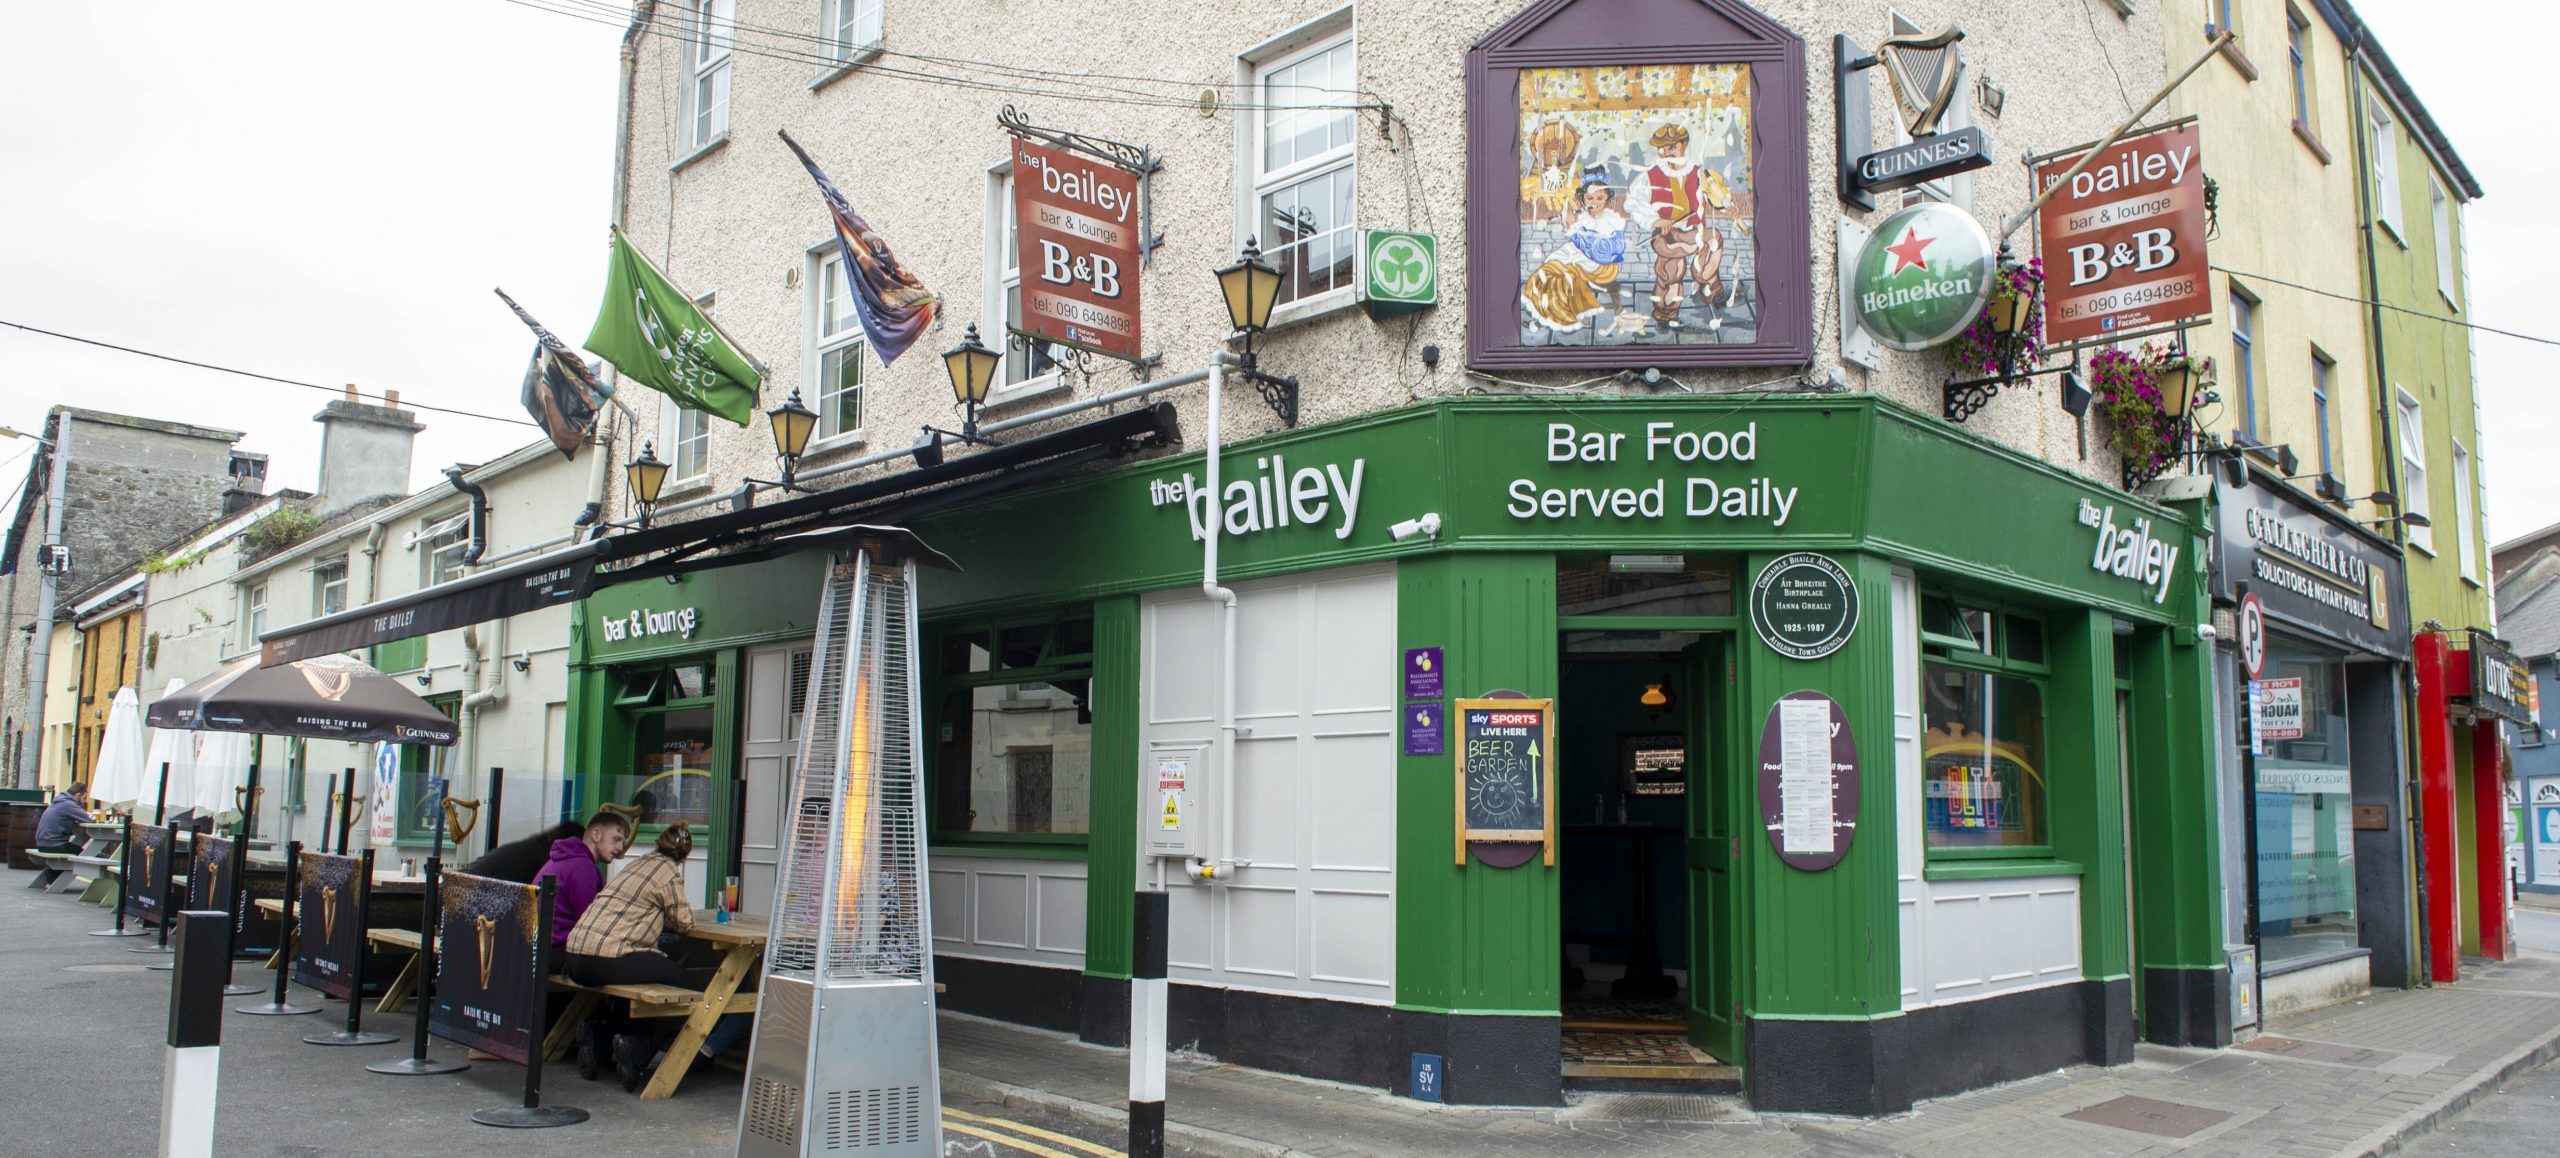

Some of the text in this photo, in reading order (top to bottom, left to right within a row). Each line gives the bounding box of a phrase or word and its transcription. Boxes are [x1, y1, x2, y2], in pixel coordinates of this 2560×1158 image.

[1862, 135, 1970, 179] GUINNESS
[1019, 150, 1132, 223] the bailey
[1040, 207, 1118, 244] bar & lounge
[2069, 197, 2171, 231] bar & lounge
[1039, 238, 1121, 299] B&B
[2067, 227, 2176, 288] B&B
[1862, 276, 1974, 315] Heineken
[2061, 280, 2194, 319] tel: 090 6494898
[1034, 296, 1131, 333] tel: 090 6494898
[2117, 314, 2151, 328] Facebook
[1547, 421, 1756, 461] Bar Food
[1150, 454, 1366, 541] the bailey
[1507, 477, 1798, 527] Served Daily
[2079, 497, 2179, 604] the bailey
[2252, 507, 2366, 586] GALLAGHER & CO
[548, 570, 558, 581] THE
[2257, 558, 2369, 620] SOLICITORS & NOTARY PUBLIC
[1776, 602, 1832, 610] HANNA GREALLY
[1784, 589, 1824, 597] BIRTHPLACE
[2373, 574, 2386, 620] G
[374, 609, 415, 633] THE BAILEY
[602, 607, 696, 641] bar & lounge
[1783, 624, 1802, 632] 1925
[2248, 610, 2258, 662] P
[1769, 635, 1843, 656] ATHLONE TOWN COUNCIL
[2486, 655, 2510, 700] LOTUS
[297, 716, 367, 729] RAISING THE BAR
[406, 727, 450, 740] GUINNESS
[1471, 713, 1537, 724] sky SPORTS
[1481, 727, 1527, 736] LIVE HERE
[1467, 757, 1528, 774] GARDEN
[1468, 739, 1514, 758] BEER
[1763, 762, 1782, 771] Food
[1836, 763, 1853, 772] 9pm
[1166, 806, 1175, 814] EX
[1419, 1071, 1434, 1084] SV
